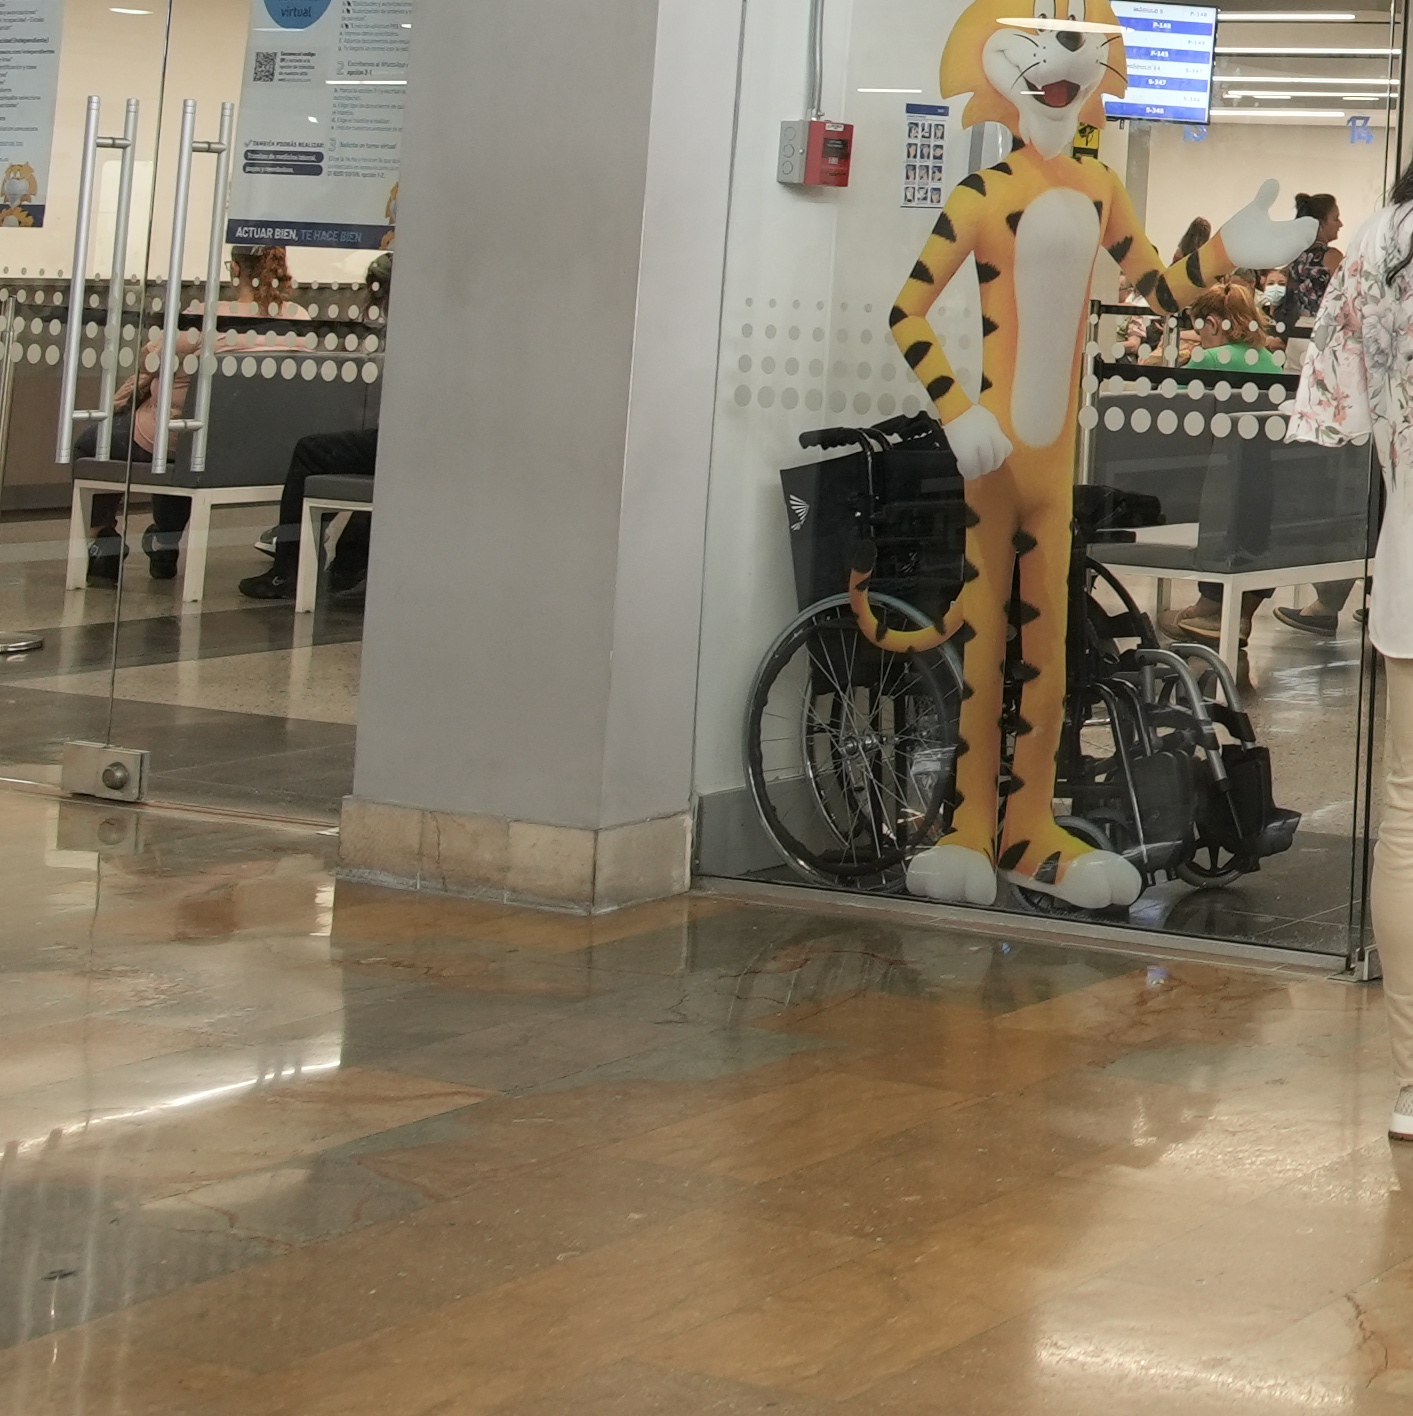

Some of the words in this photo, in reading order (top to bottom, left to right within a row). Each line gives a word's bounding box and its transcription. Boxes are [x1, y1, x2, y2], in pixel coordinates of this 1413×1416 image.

[281, 6, 312, 18] virtual
[236, 226, 273, 239] ACTUAR
[275, 228, 299, 241] BIEN,
[301, 229, 312, 240] TE
[314, 230, 340, 241] HACE
[342, 231, 363, 243] BIEN
